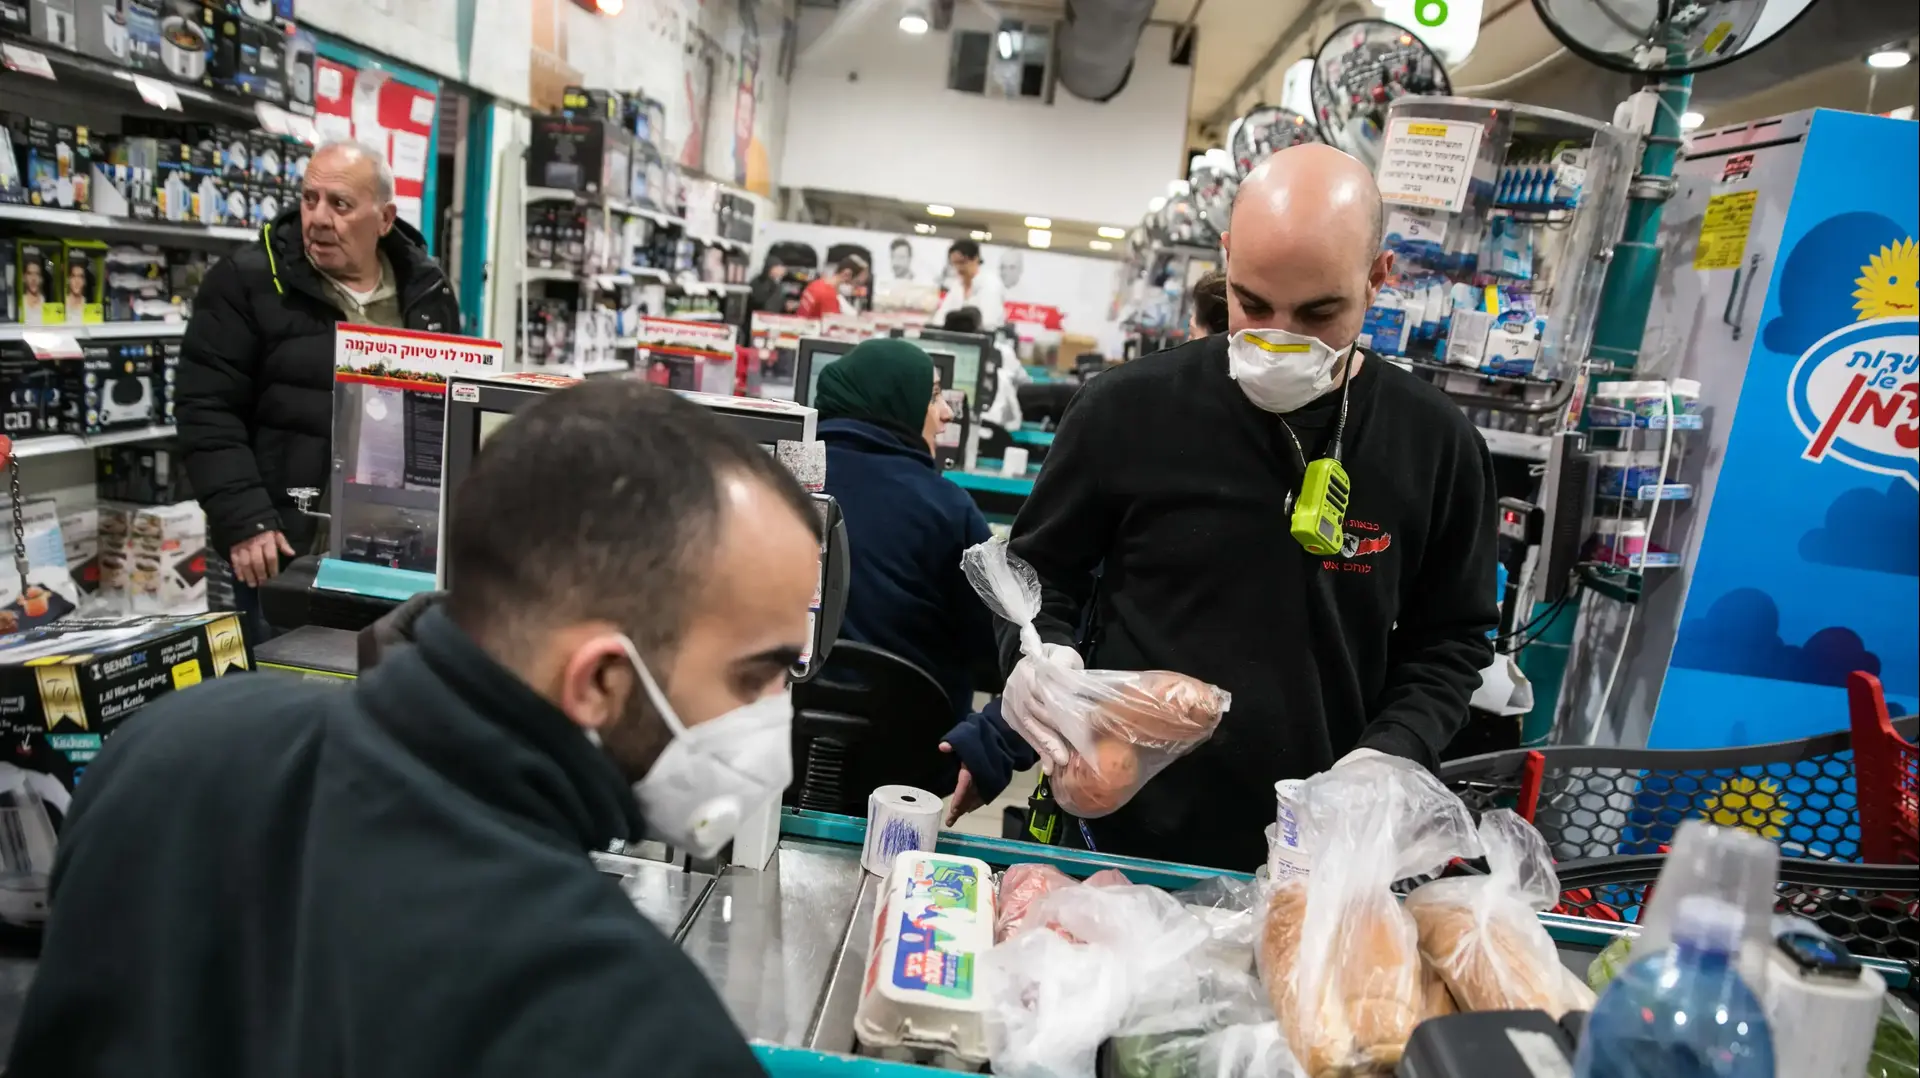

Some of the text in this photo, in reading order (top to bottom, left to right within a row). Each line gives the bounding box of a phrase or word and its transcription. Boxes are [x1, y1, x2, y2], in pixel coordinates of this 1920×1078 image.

[1415, 0, 1448, 27] 6
[345, 338, 482, 364] רמי לוי שיווק השקמה
[1867, 368, 1898, 389] של
[1350, 520, 1380, 531] כבאות
[1322, 560, 1372, 573] לוחם אש
[114, 684, 137, 697] Warm
[138, 673, 168, 689] Keeping
[101, 704, 122, 717] Glass
[122, 694, 146, 709] Kettle
